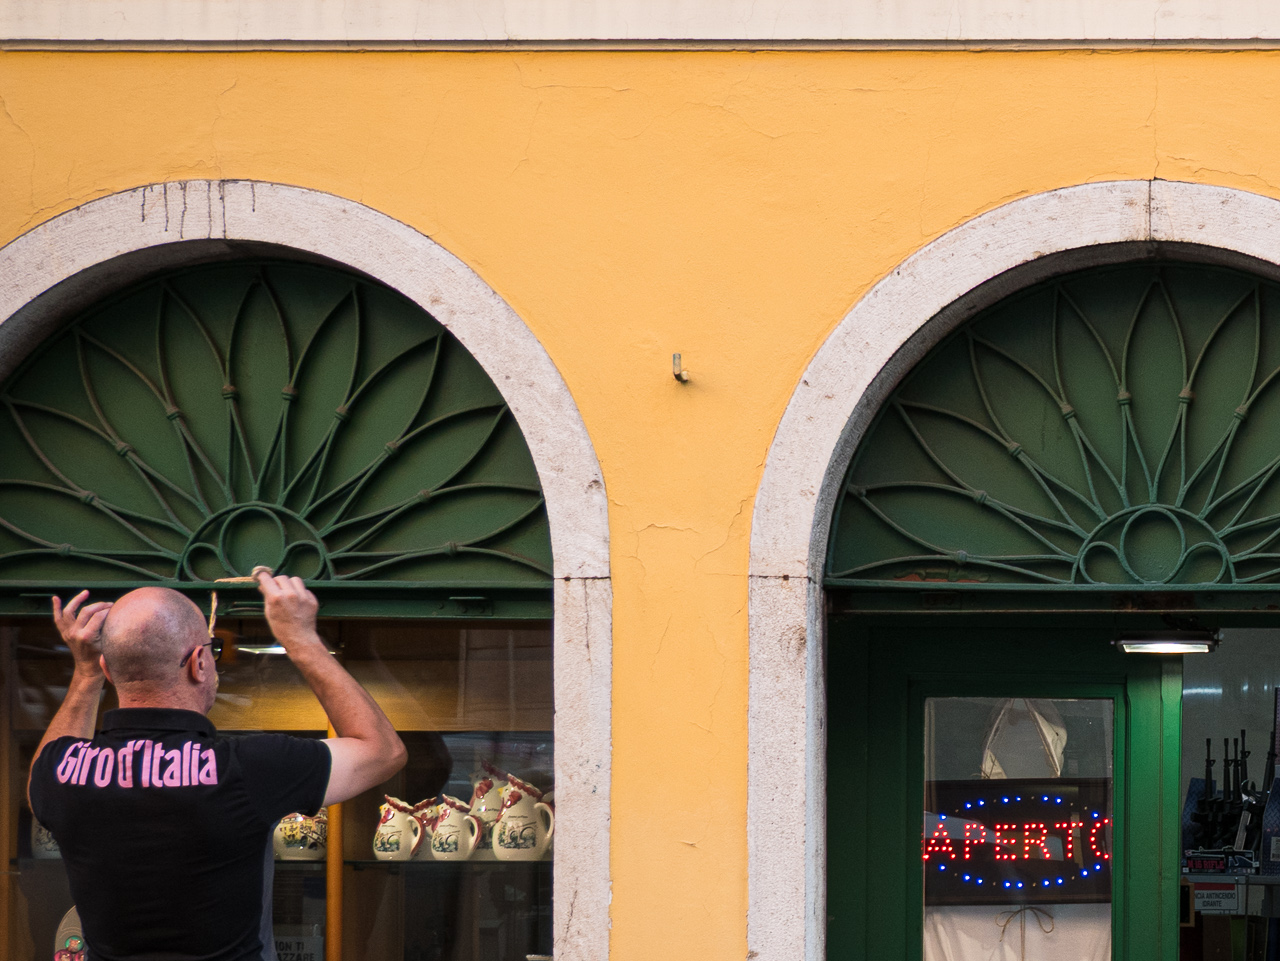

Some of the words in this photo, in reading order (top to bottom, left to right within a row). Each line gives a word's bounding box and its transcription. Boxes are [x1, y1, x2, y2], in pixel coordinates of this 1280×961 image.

[56, 739, 116, 788] Giro
[117, 739, 219, 788] d'Italia
[1203, 859, 1226, 869] RIFLE
[1205, 892, 1236, 900] ANTINCENDIO
[1201, 900, 1223, 908] IDRANTE
[296, 941, 305, 952] TI
